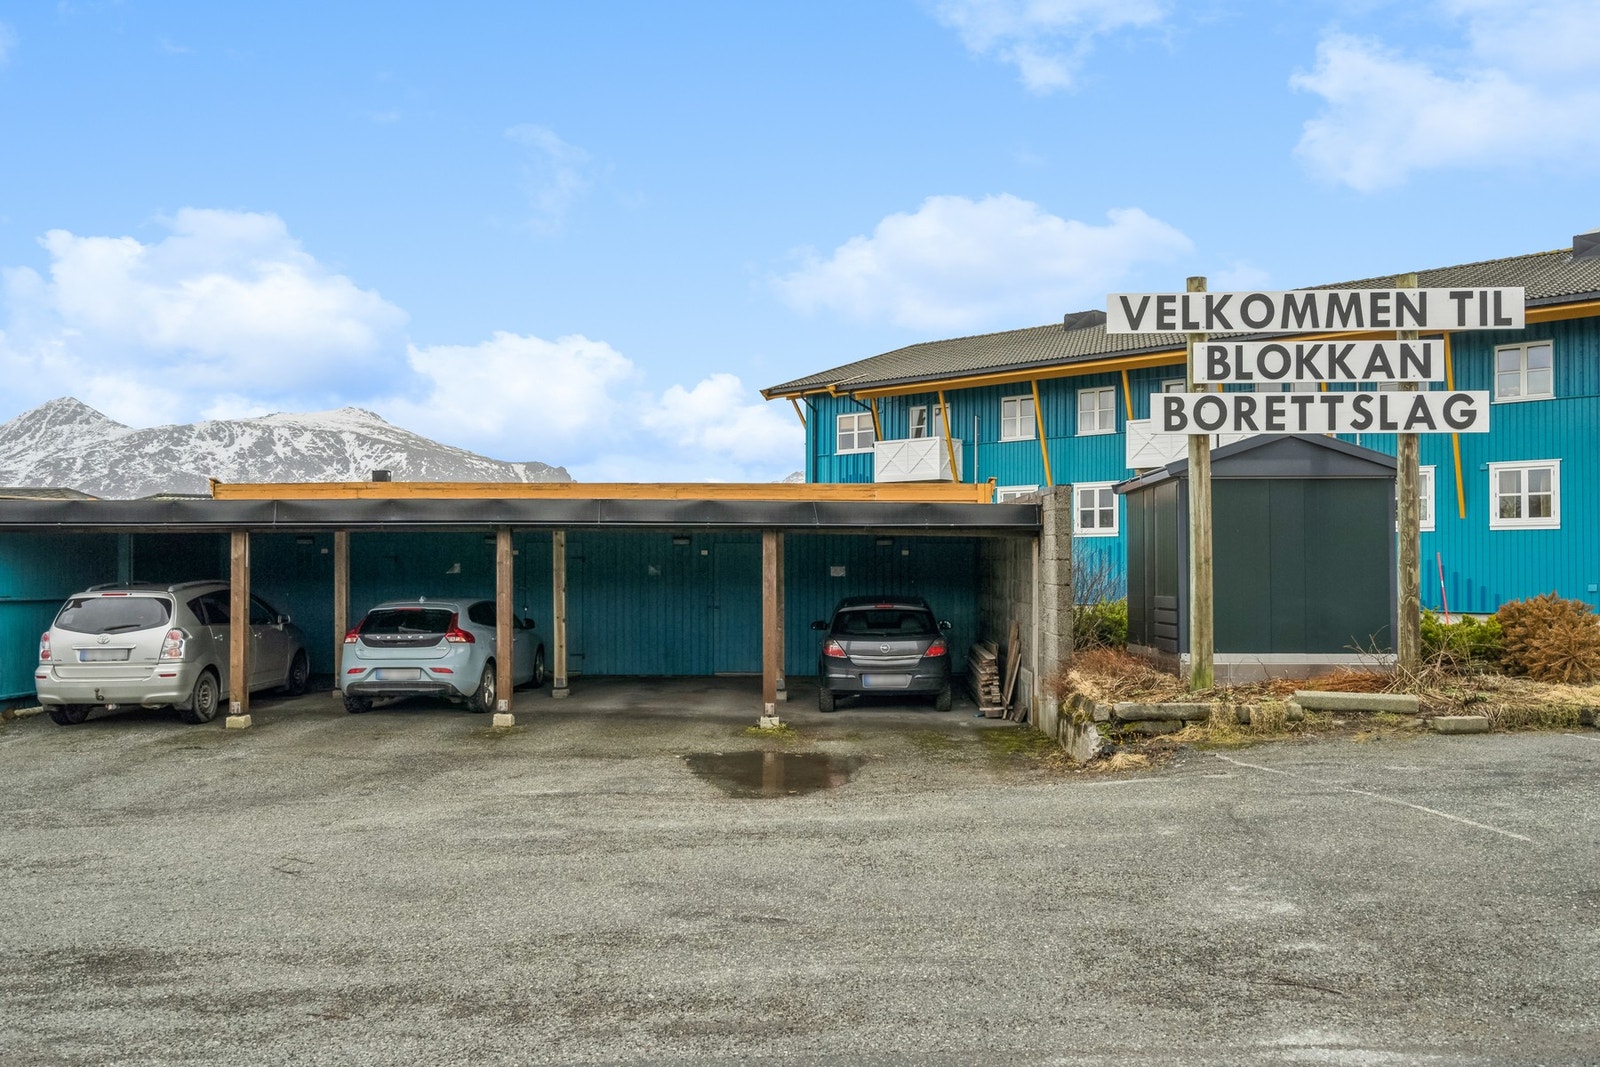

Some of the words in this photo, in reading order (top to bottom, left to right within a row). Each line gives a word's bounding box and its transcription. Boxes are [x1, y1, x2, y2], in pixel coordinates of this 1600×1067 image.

[1119, 292, 1427, 331] VELKOMMEN
[1449, 291, 1513, 327] TIL
[1206, 343, 1432, 381] BLOKKAN
[1164, 393, 1477, 432] BORETTSLAG
